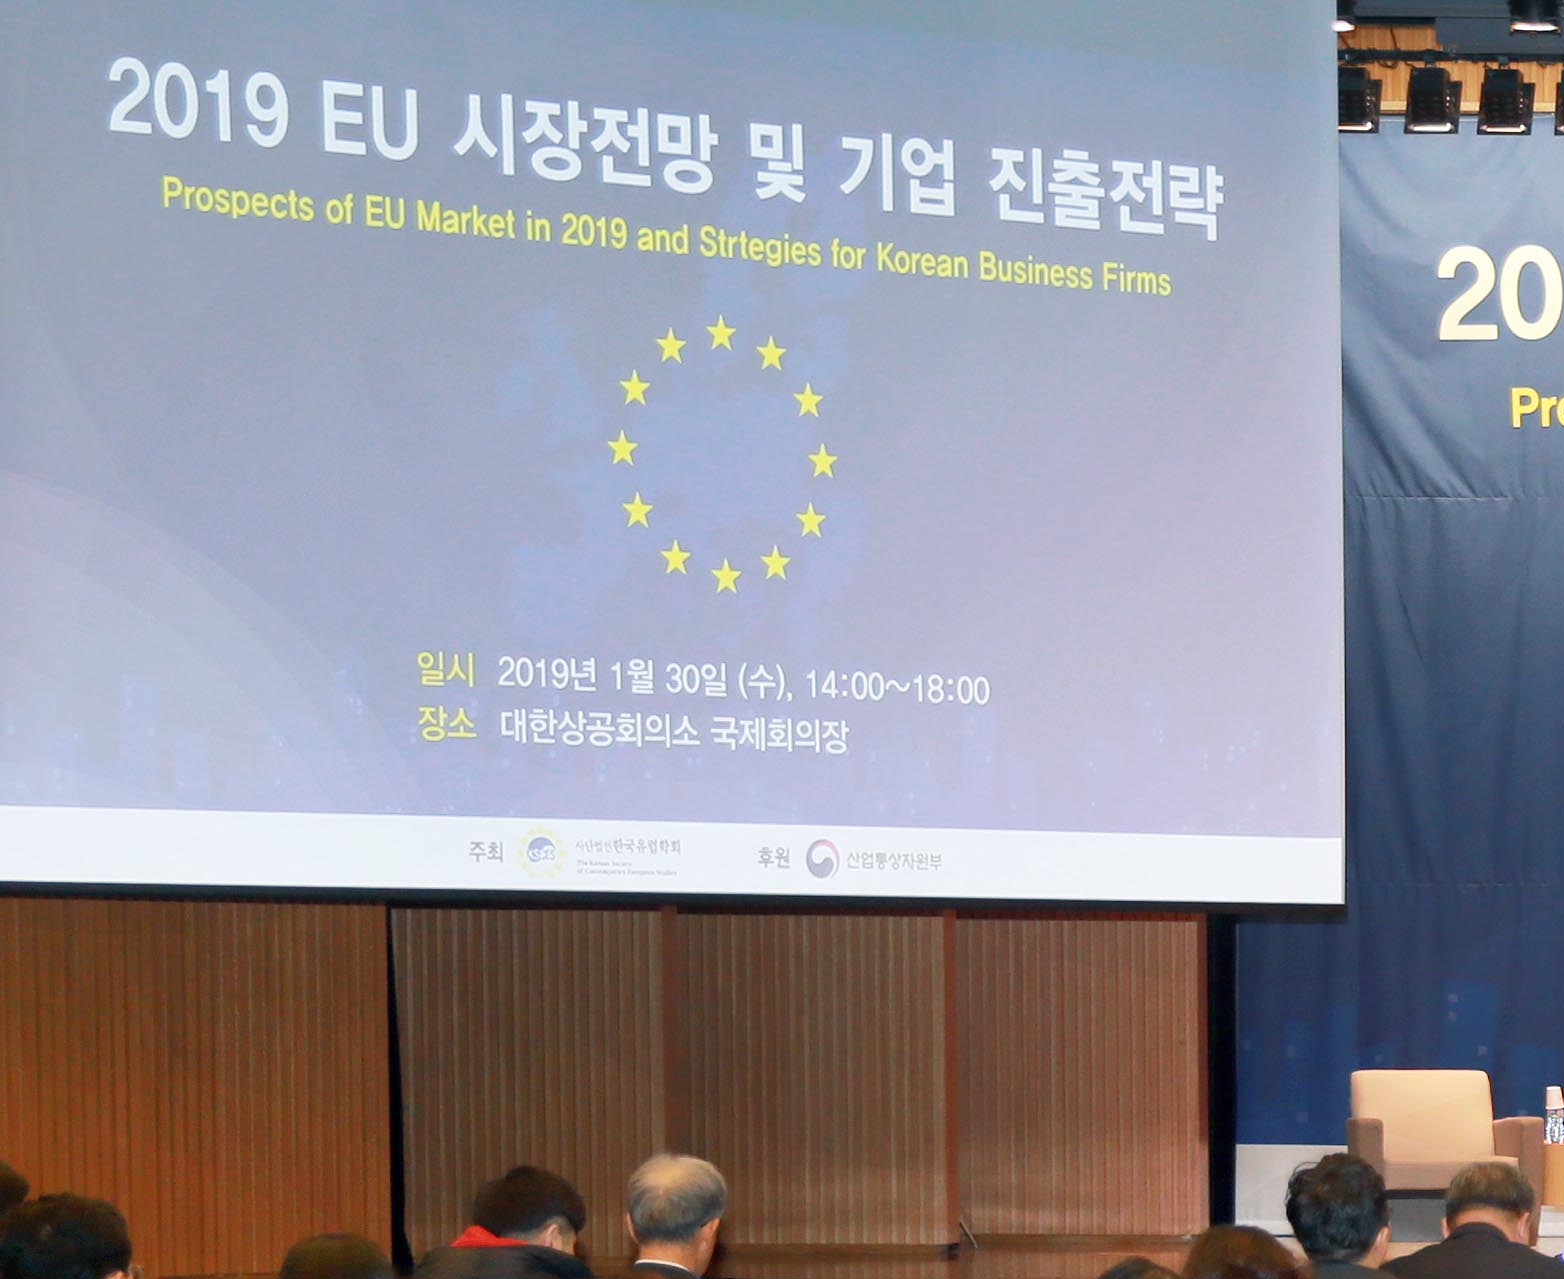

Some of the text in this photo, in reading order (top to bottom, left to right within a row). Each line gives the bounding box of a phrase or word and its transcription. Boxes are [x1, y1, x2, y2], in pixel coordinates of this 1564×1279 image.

[107, 55, 1225, 243] 2019 EU 시장전망 및 기업 진출전략
[161, 175, 1173, 296] Prospects of EU Market in 2019 and Strtegies for Korean Business Firms
[416, 650, 476, 687] 일시
[498, 655, 597, 692] 2019년
[610, 658, 654, 695] 1월
[665, 662, 728, 697] 30일
[738, 662, 793, 702] (수),
[417, 705, 850, 754] 장소 대한상공회의소 국제회의장
[468, 841, 504, 864] 주최
[757, 846, 790, 869] 후원
